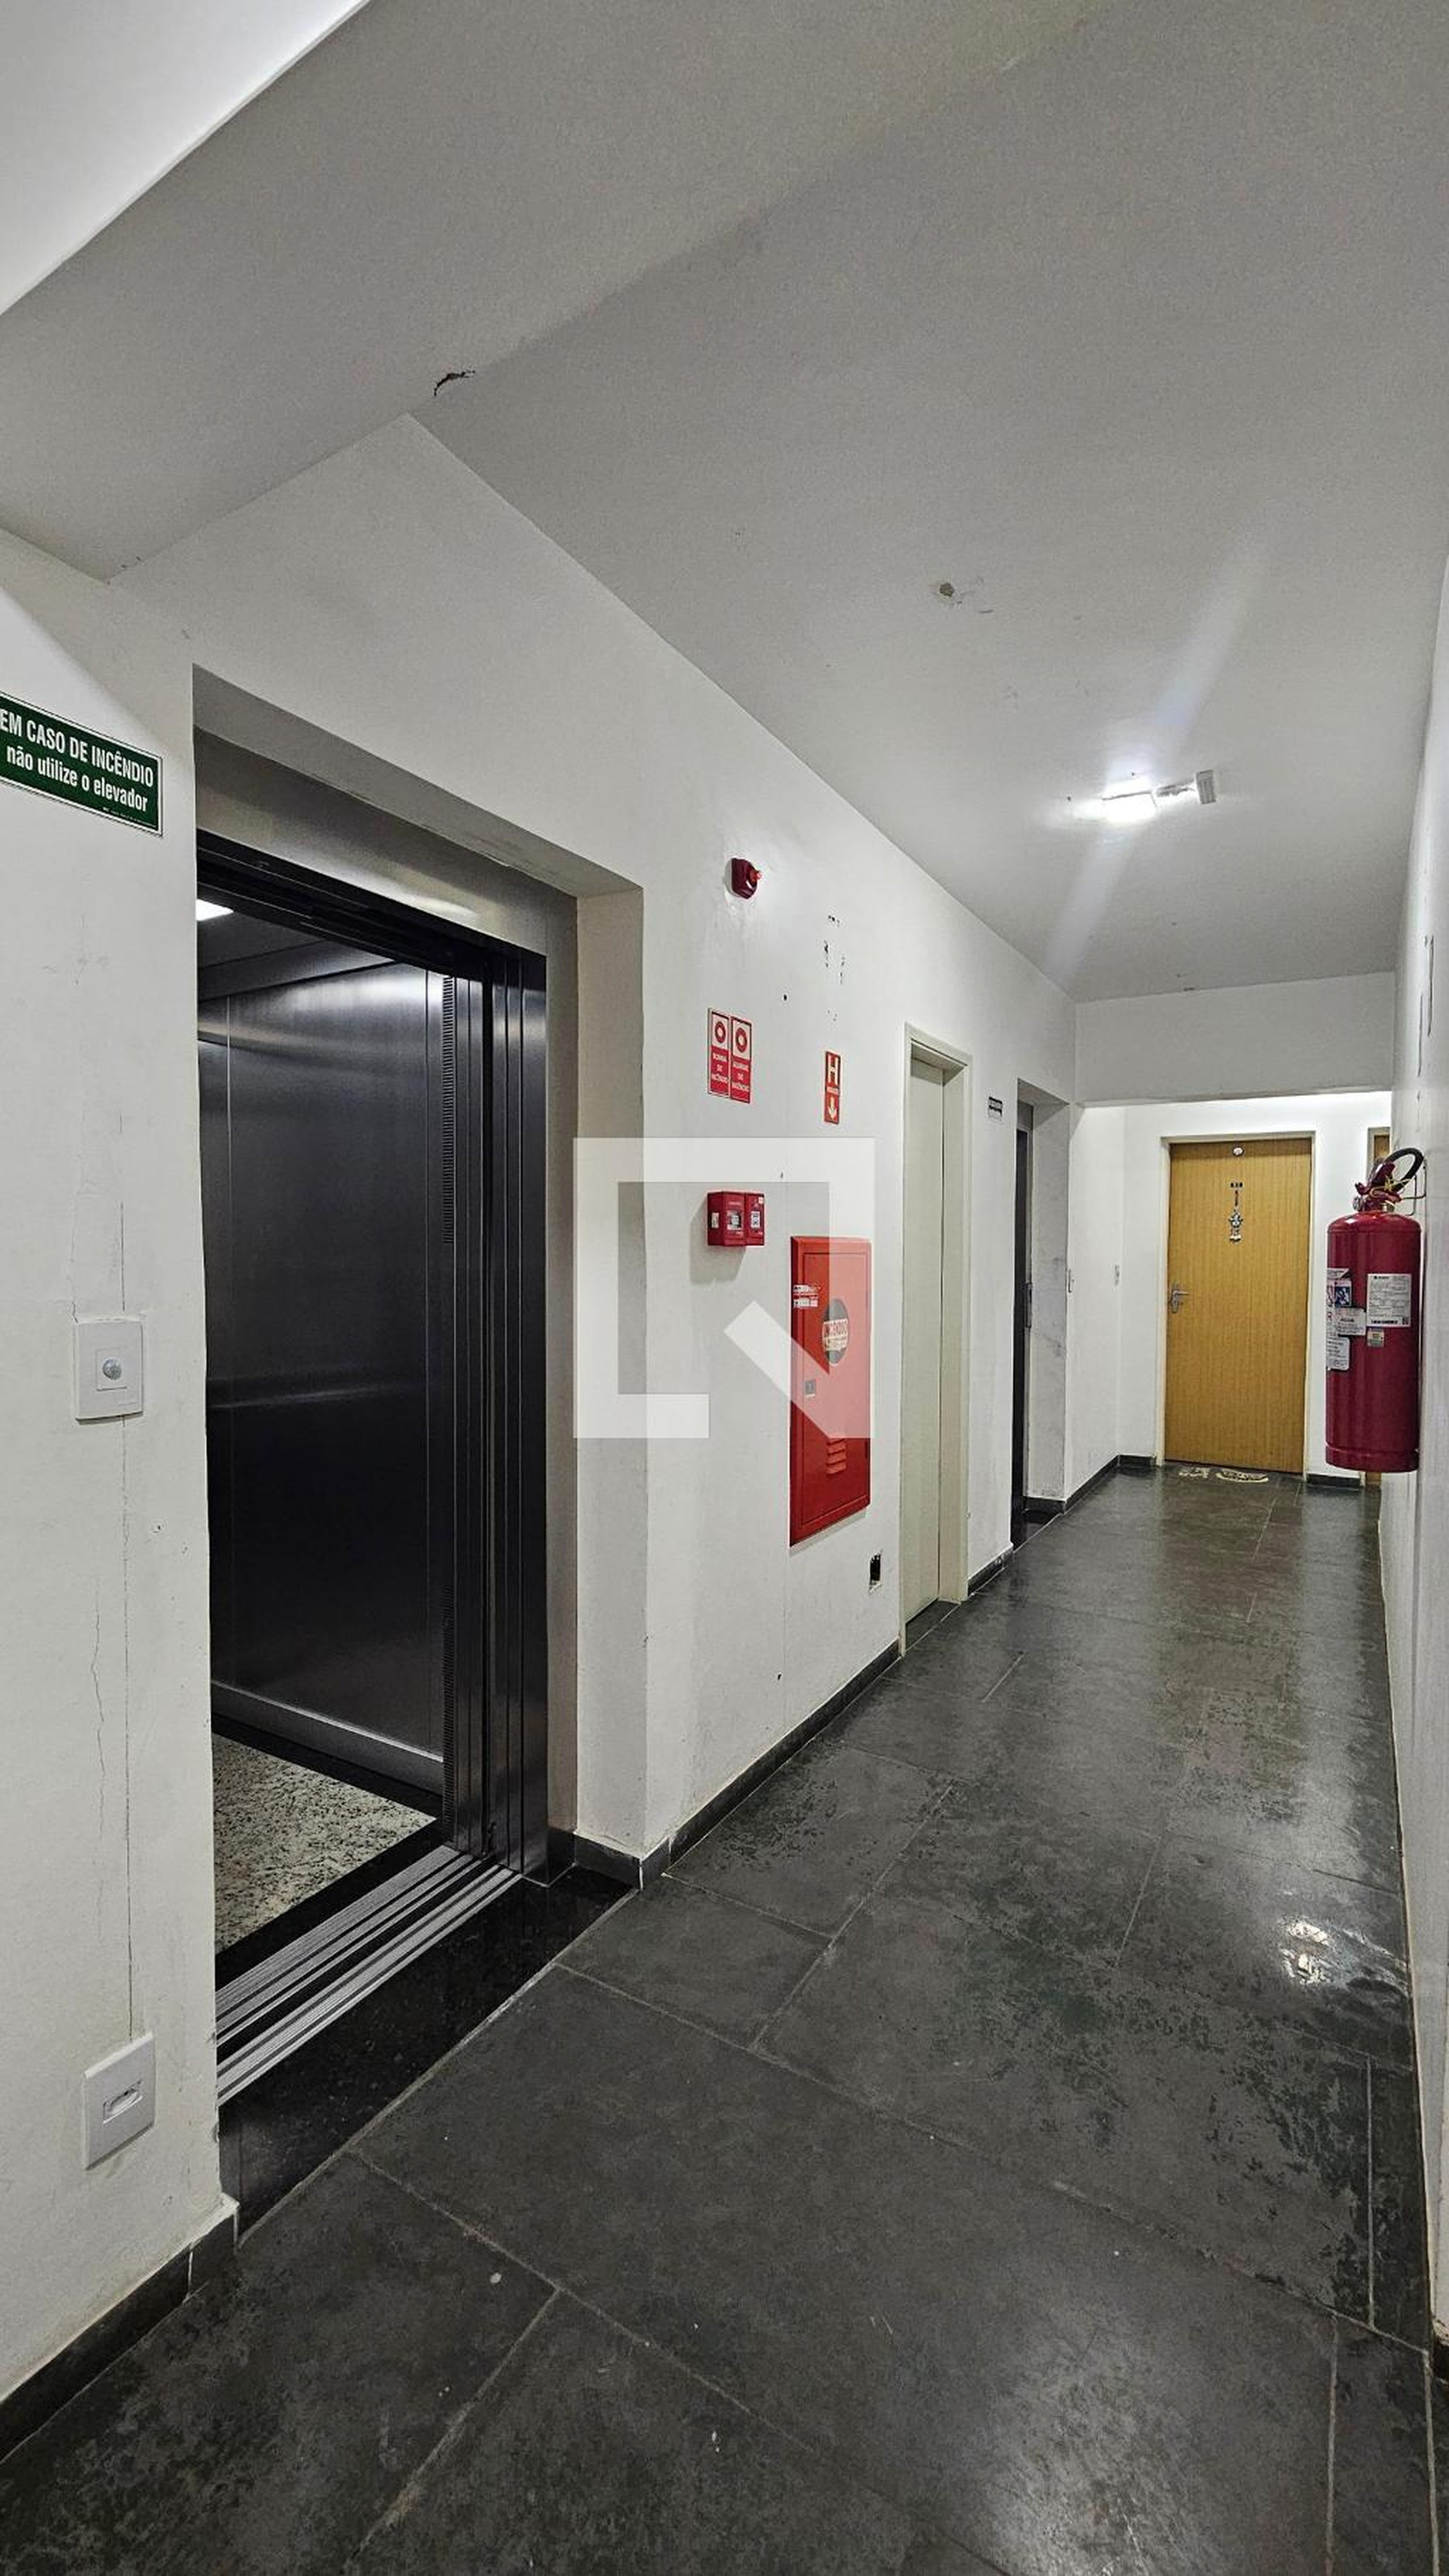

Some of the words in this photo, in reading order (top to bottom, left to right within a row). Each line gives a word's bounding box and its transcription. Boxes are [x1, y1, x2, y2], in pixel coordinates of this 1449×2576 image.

[0, 708, 22, 737] EM
[27, 720, 65, 754] CASO
[70, 737, 88, 763] DE
[92, 745, 153, 787] INCÊNDIO
[7, 745, 33, 770] não
[38, 756, 78, 786] utilize
[82, 774, 89, 791] o
[94, 777, 148, 812] elevador
[828, 1055, 838, 1086] H
